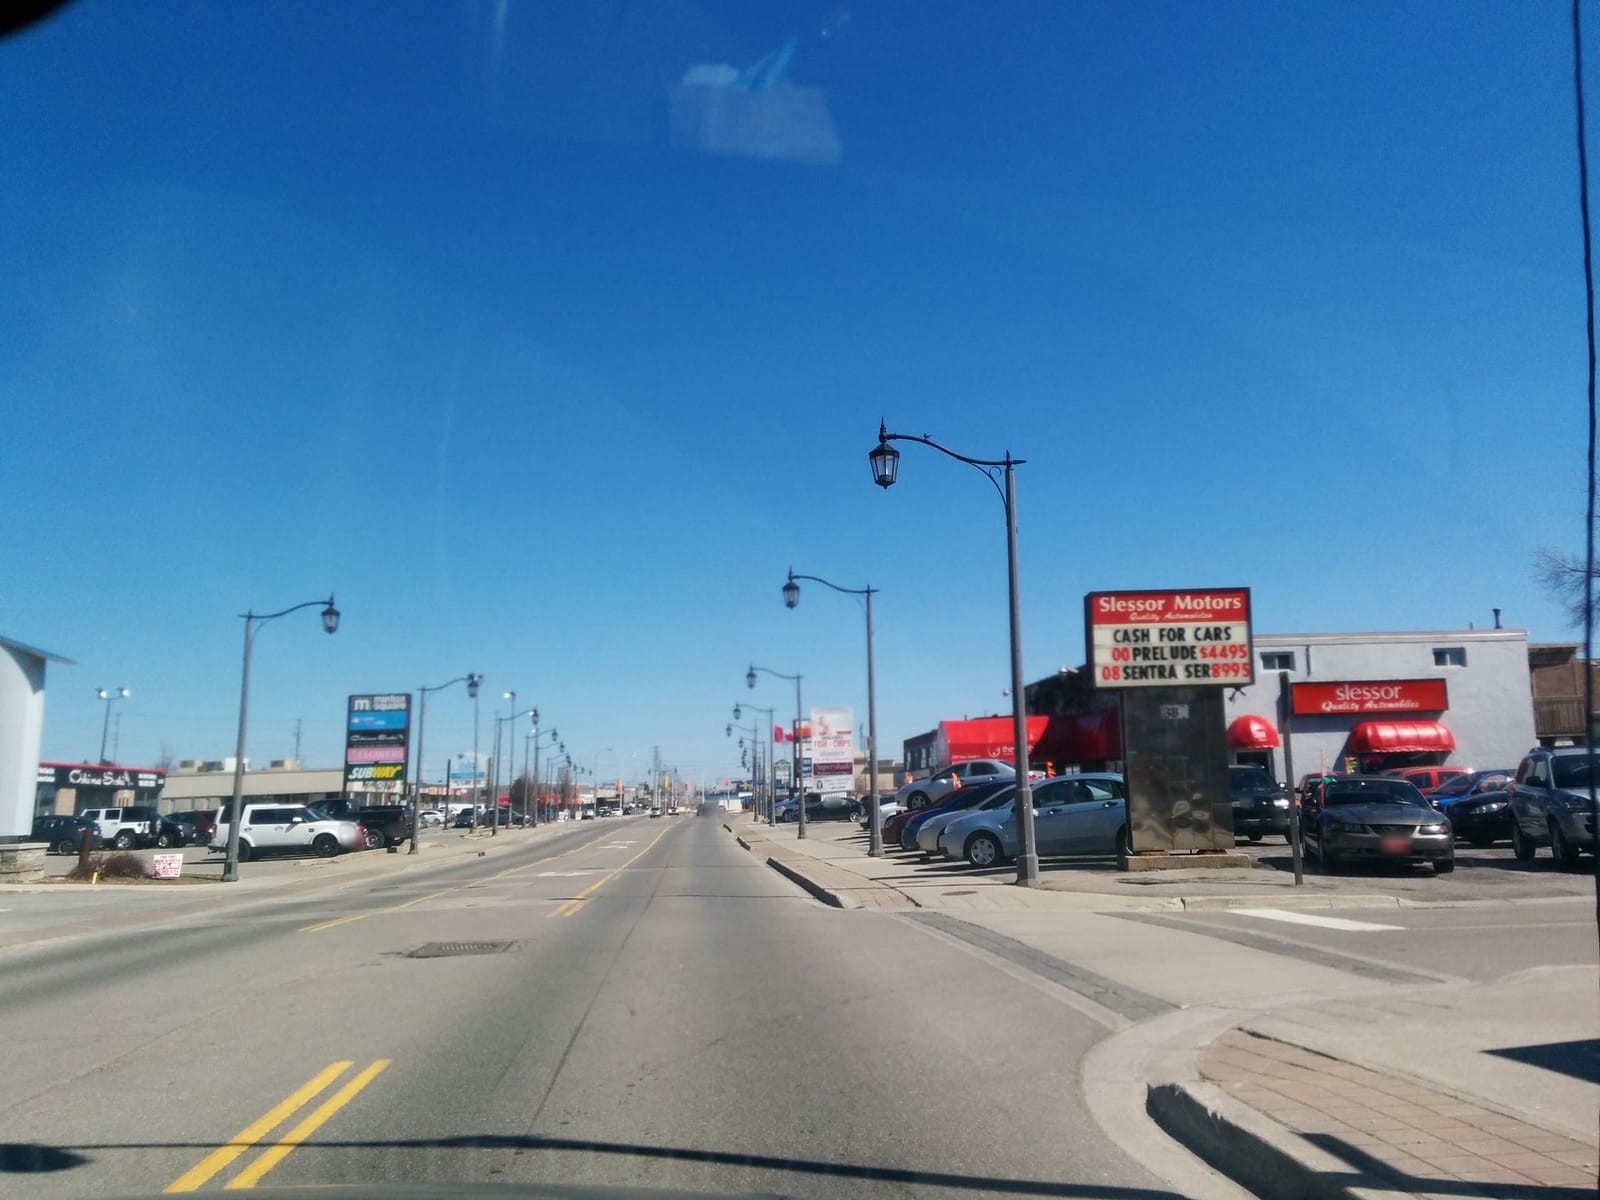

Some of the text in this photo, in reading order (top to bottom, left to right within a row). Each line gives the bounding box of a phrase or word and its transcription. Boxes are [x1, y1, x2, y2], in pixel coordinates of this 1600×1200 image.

[1100, 594, 1242, 613] Slessor Motors
[1113, 626, 1232, 643] CASH FOR CARS
[1112, 643, 1248, 662] 00 PRELUDE $4495
[1102, 665, 1121, 681] 08
[1123, 664, 1178, 681] SENTRA
[1184, 663, 1212, 679] SER
[1335, 684, 1402, 700] slessor
[1321, 699, 1420, 711] Quality Automobiles
[348, 765, 402, 779] SUBWAY
